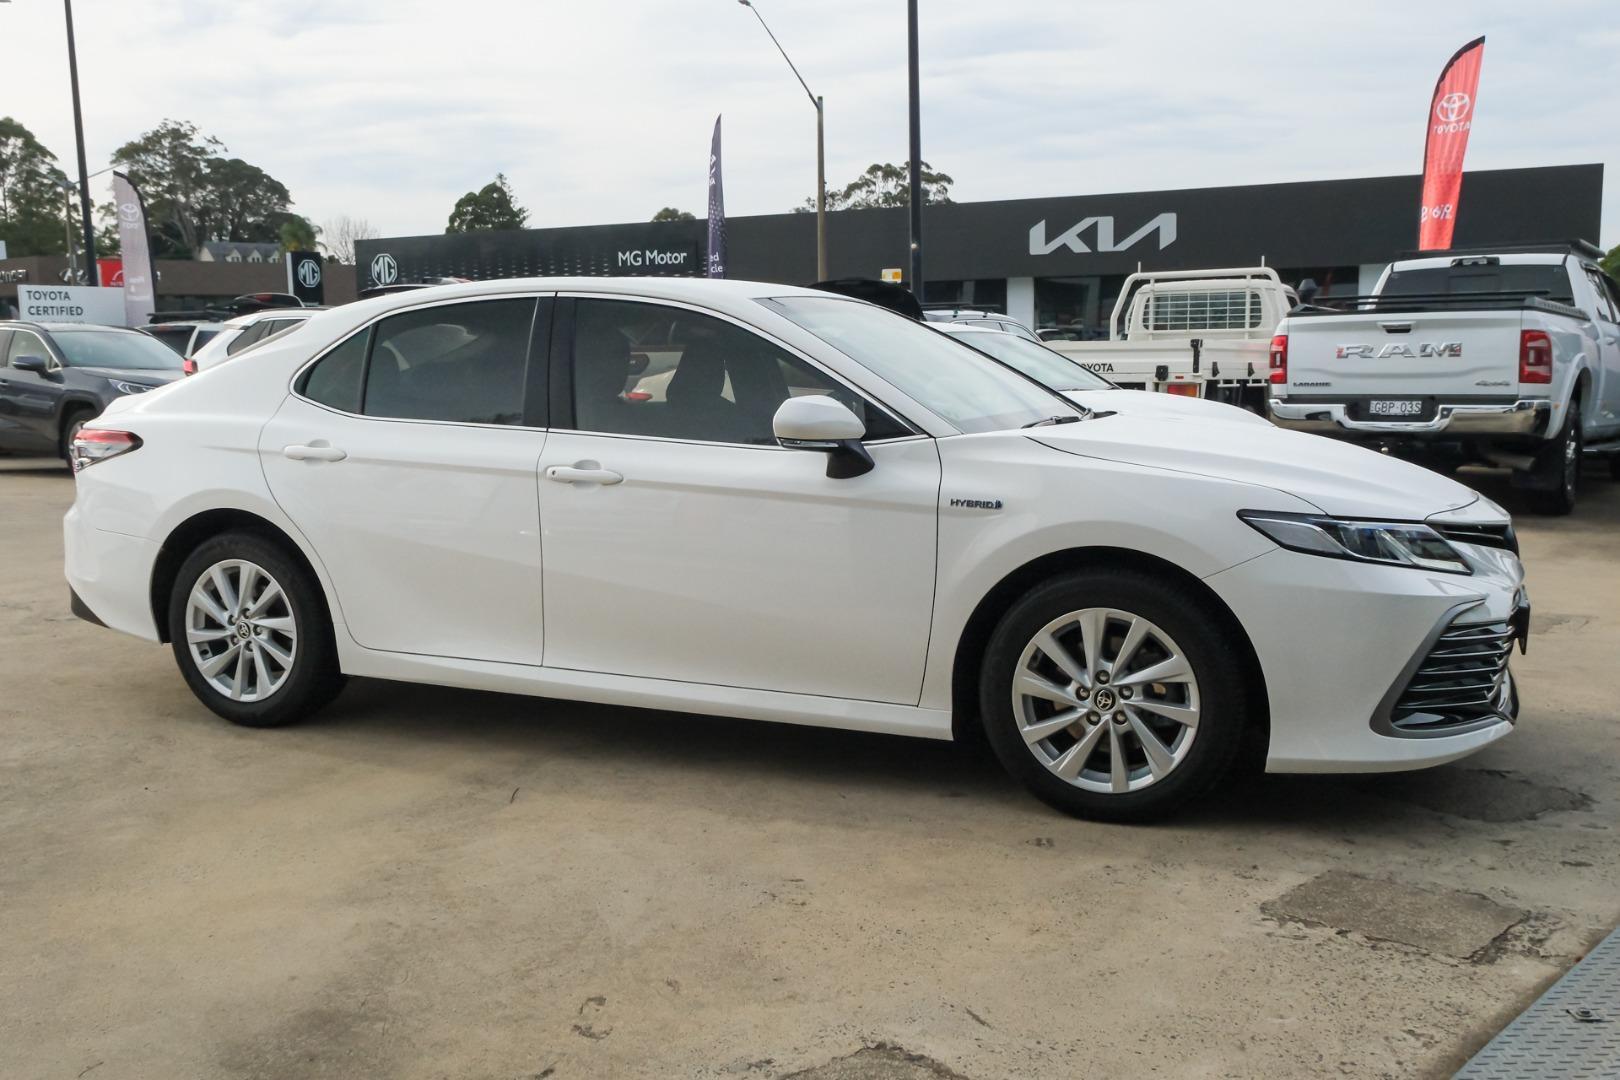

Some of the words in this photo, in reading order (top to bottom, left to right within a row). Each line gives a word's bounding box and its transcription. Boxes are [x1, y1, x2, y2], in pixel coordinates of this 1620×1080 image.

[1029, 212, 1177, 255] KIA
[618, 250, 642, 266] MG
[645, 249, 687, 265] Motor
[299, 261, 319, 286] MG
[373, 255, 396, 285] MG
[26, 290, 71, 301] TOYOTA
[28, 305, 83, 316] CERTIFIED
[1335, 342, 1463, 359] RAM
[1081, 362, 1114, 373] YOTA
[950, 498, 994, 510] HYBRID
